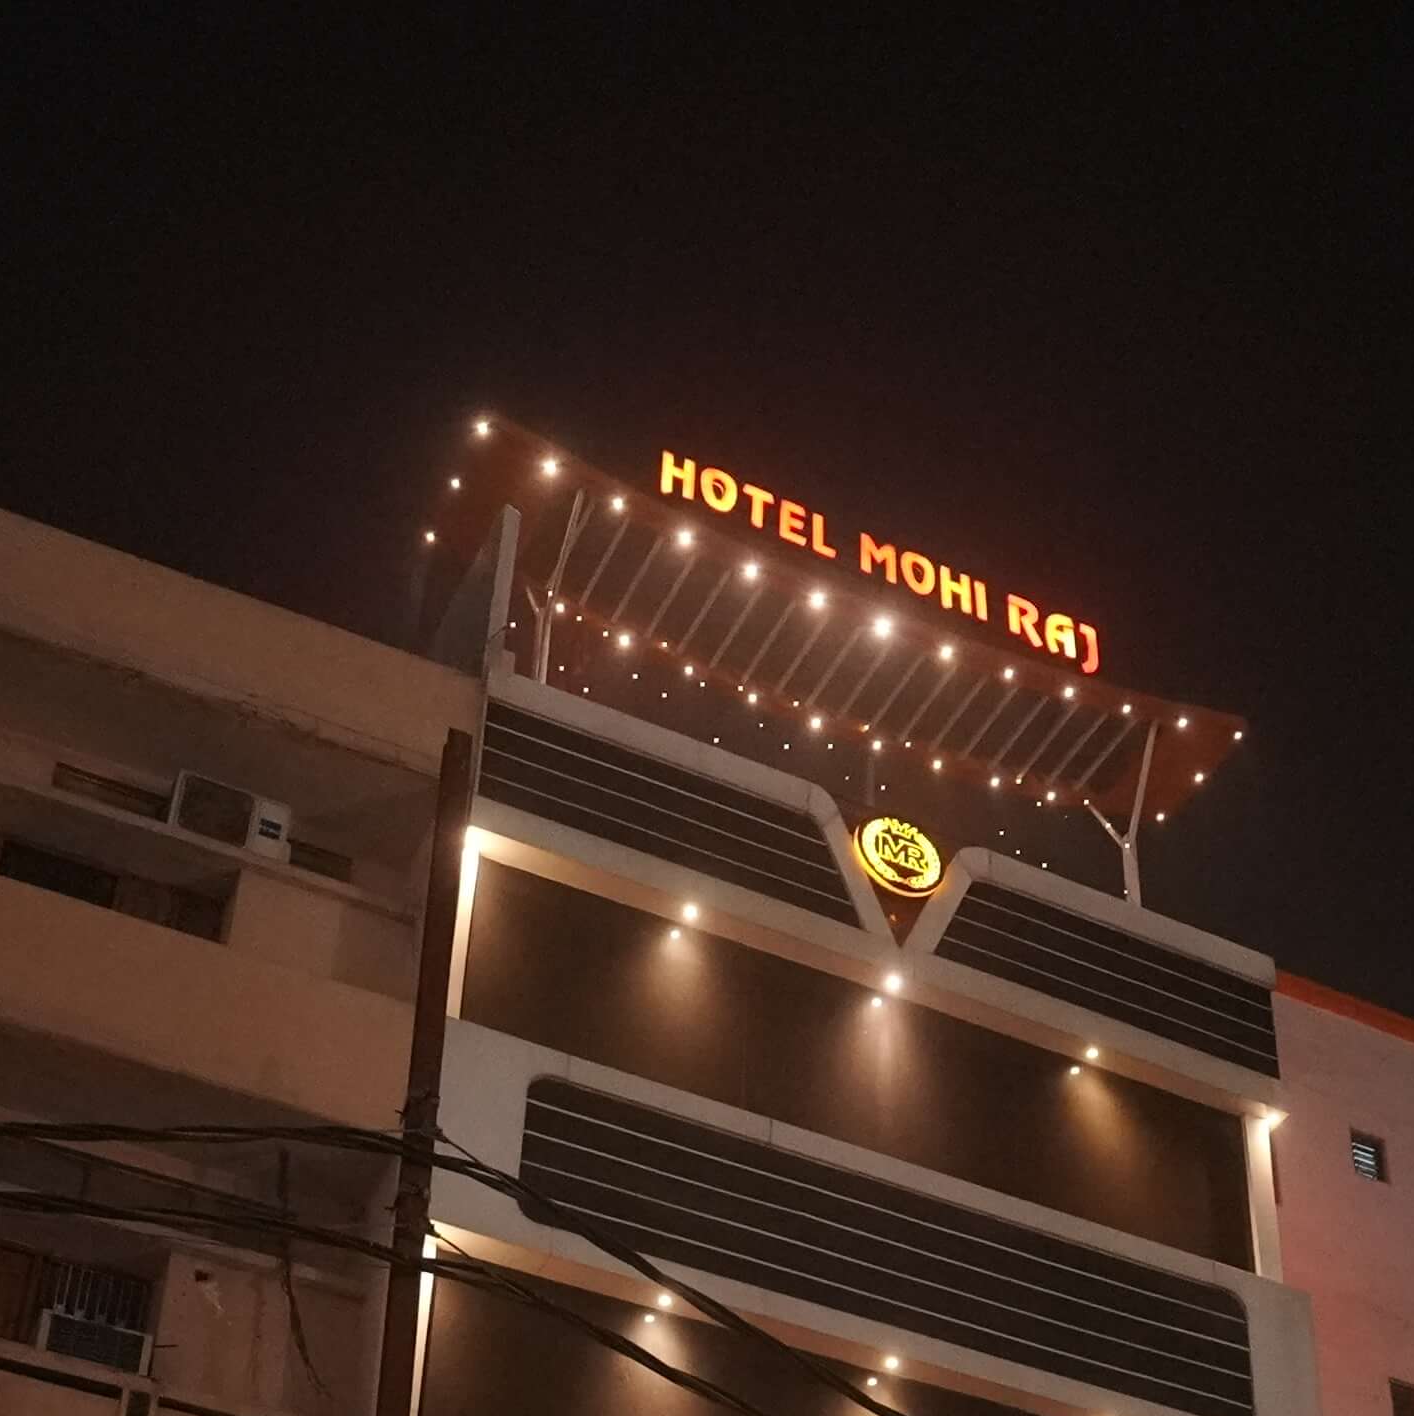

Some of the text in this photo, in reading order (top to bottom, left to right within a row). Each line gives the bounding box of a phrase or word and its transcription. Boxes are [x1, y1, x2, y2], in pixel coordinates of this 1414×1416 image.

[660, 450, 1099, 673] HOTEL MOHI RAJ
[878, 834, 929, 871] MR
